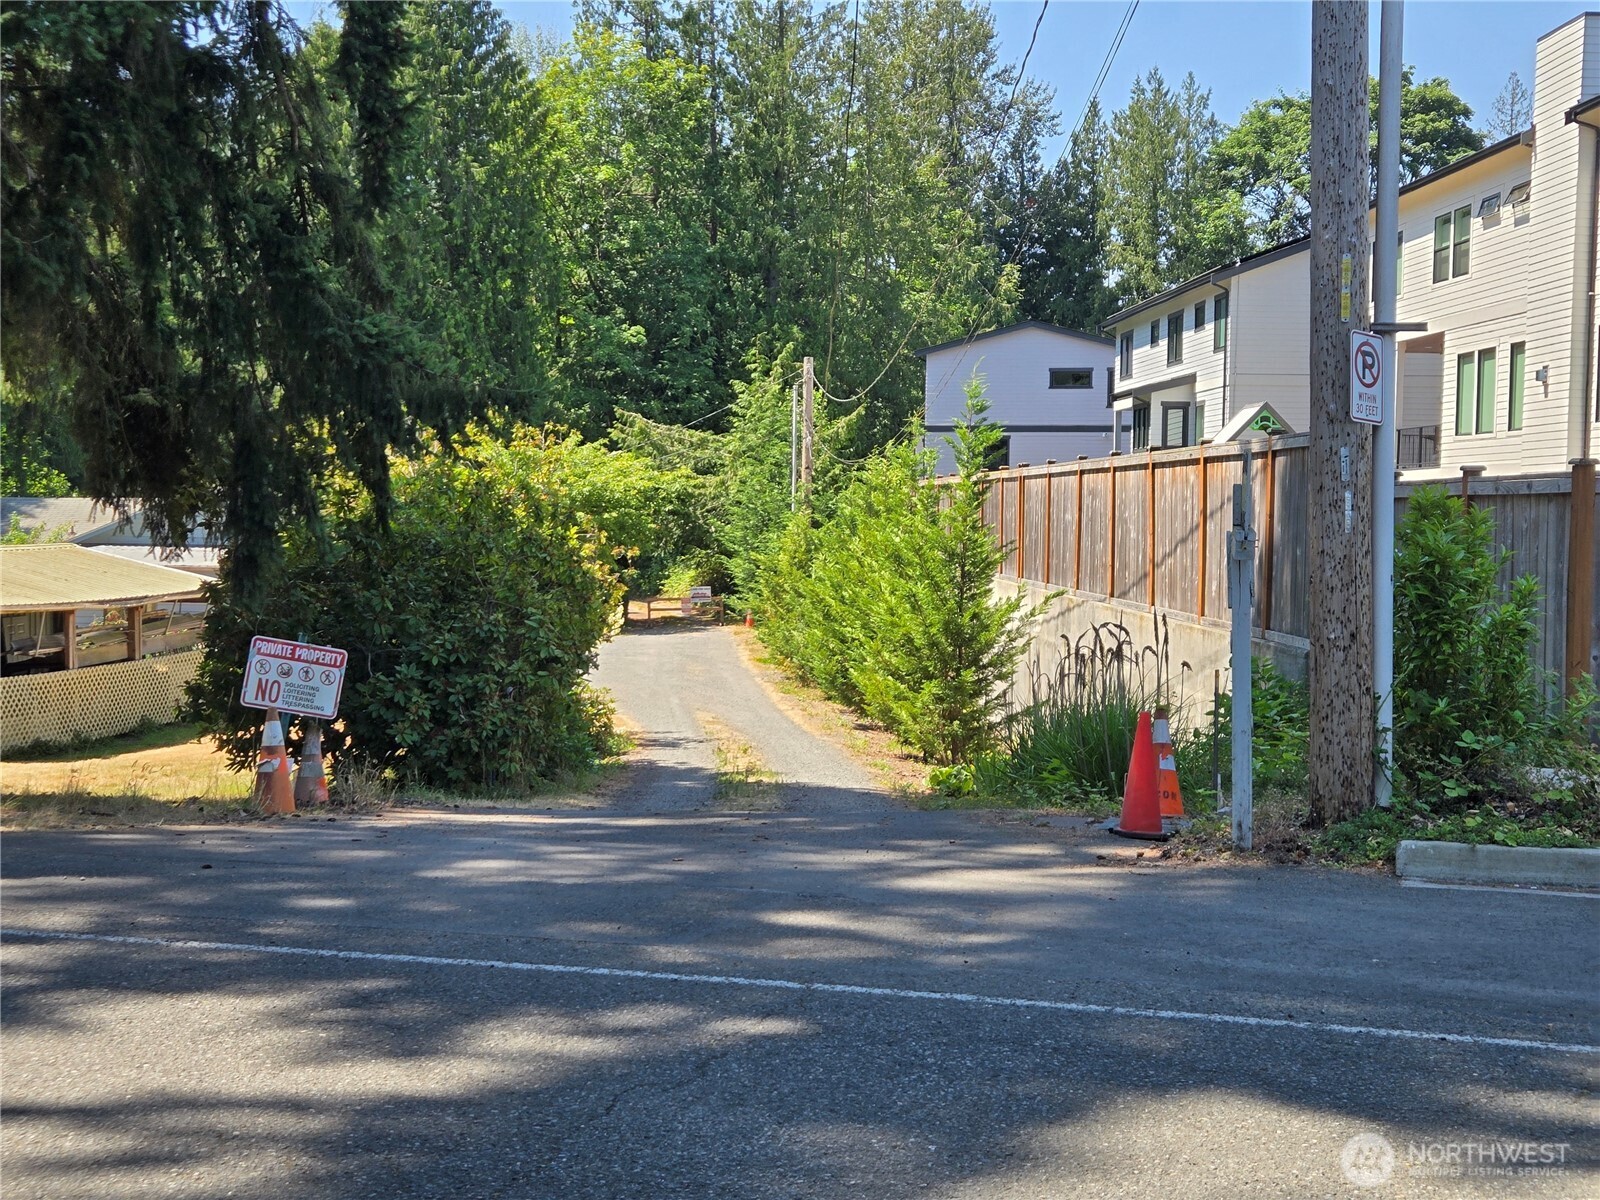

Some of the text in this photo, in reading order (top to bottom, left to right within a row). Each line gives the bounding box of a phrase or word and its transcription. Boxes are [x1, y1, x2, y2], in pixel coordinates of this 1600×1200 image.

[1358, 392, 1377, 404] WITHIN
[1356, 403, 1379, 416] 30 FEET
[255, 640, 344, 666] PRIVATE PROPERTY
[254, 677, 281, 704] NO
[283, 688, 317, 698] LOITERING
[284, 682, 320, 692] SOLICITING
[282, 694, 315, 704] LITTERING
[281, 700, 325, 712] TRESPASSING
